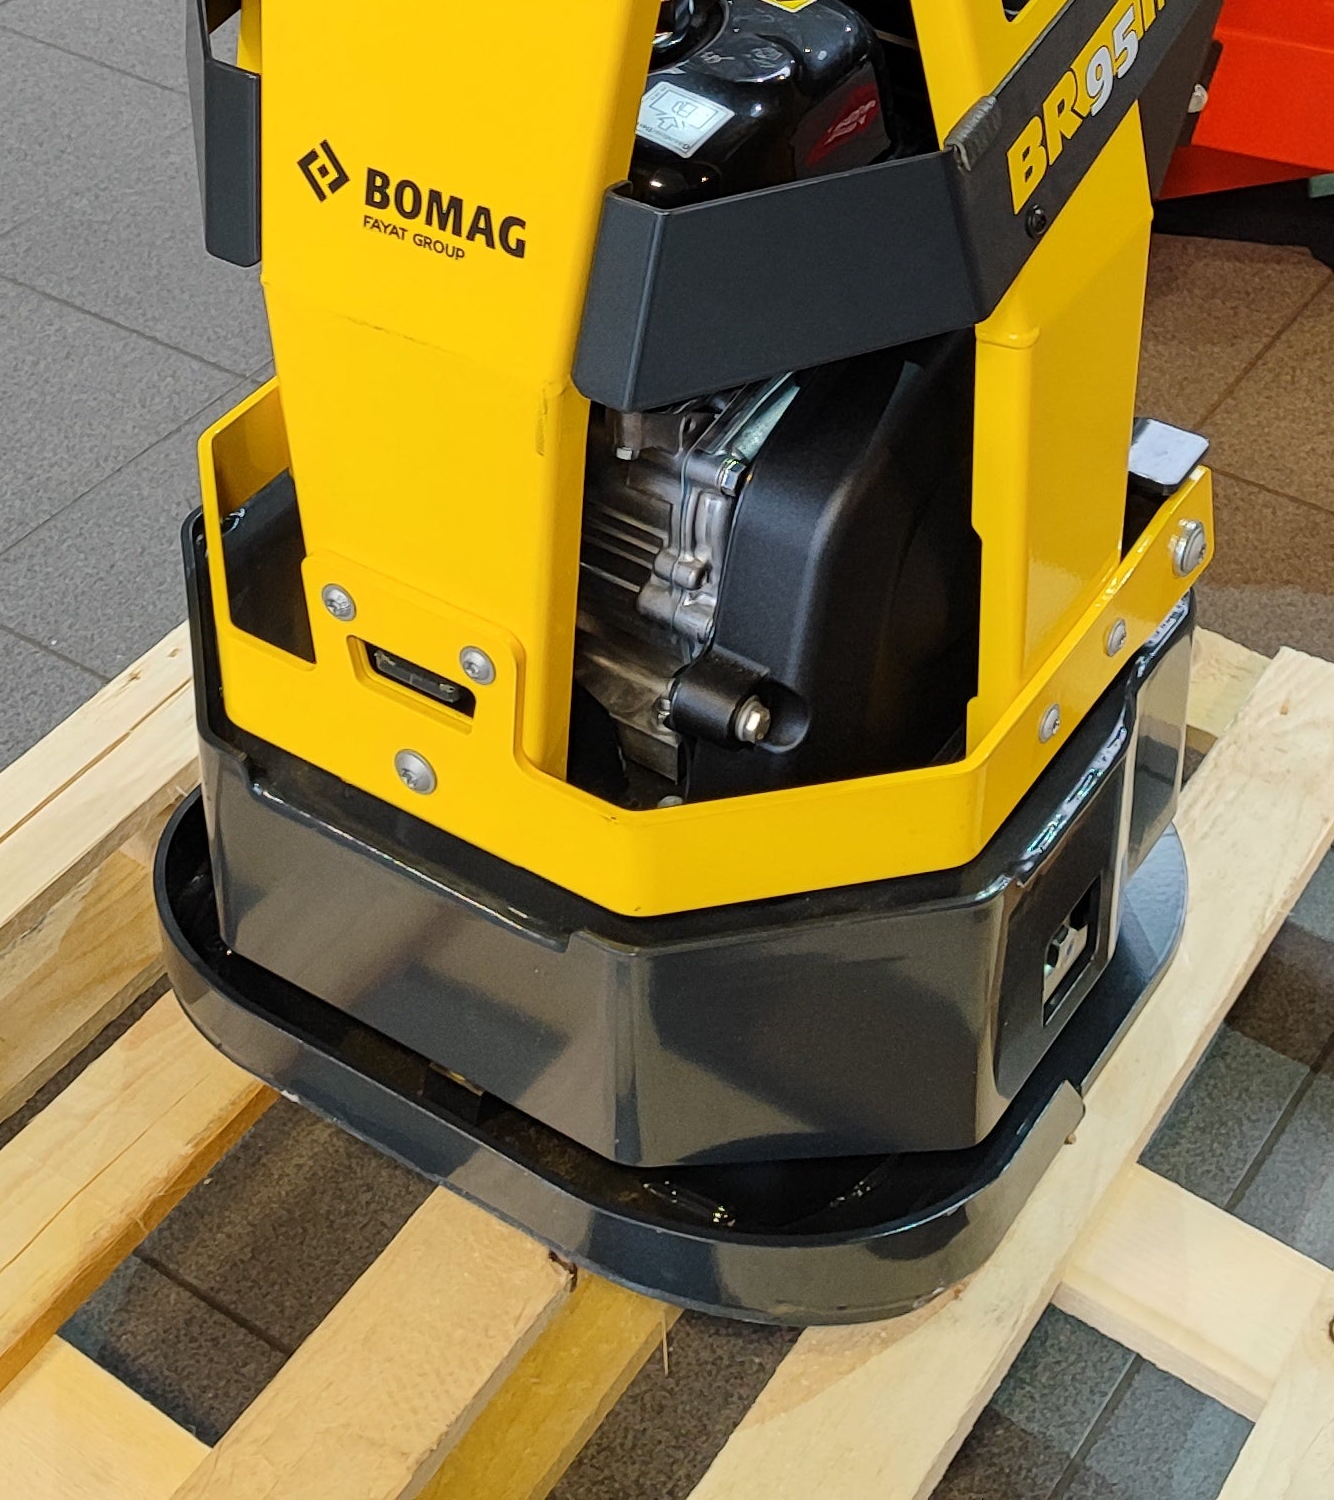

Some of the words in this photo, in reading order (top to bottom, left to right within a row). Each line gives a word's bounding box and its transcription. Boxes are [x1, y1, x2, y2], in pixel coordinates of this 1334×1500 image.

[363, 215, 408, 241] FAYAT
[412, 233, 465, 260] GROUP
[364, 166, 526, 259] BOMAG
